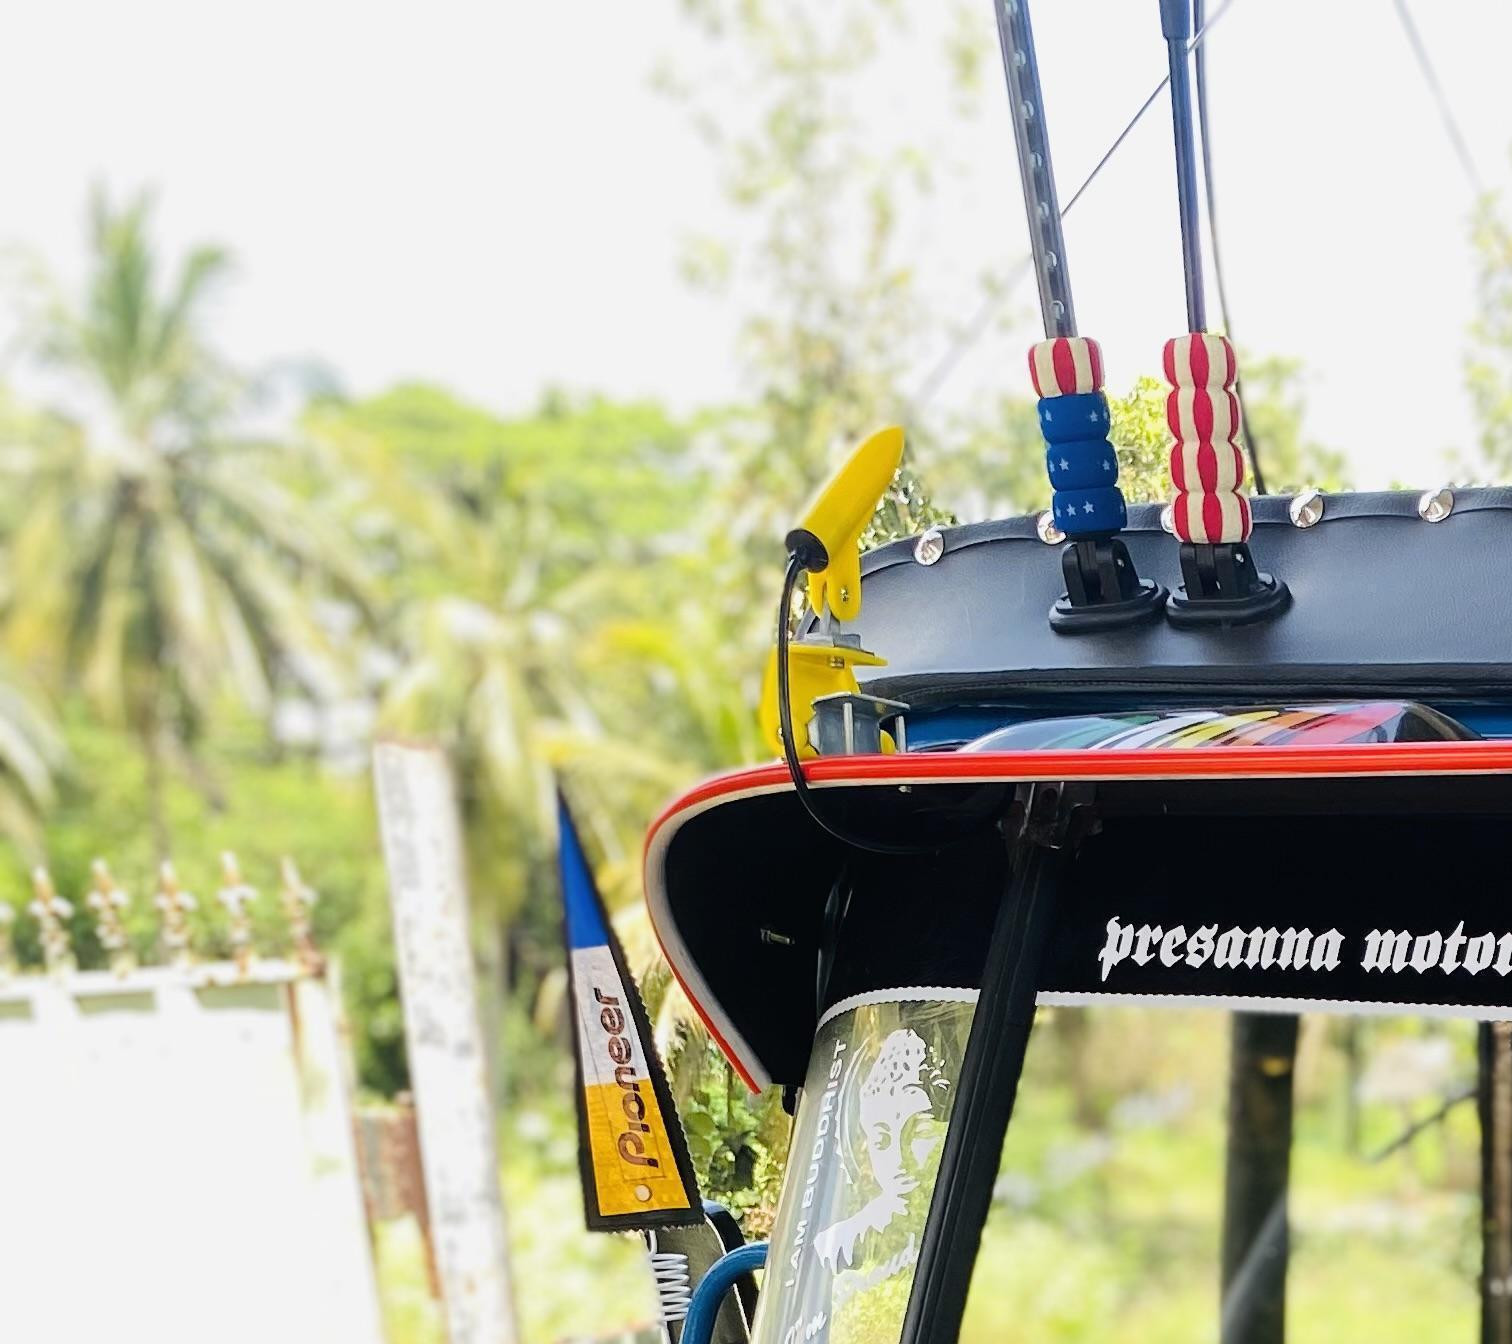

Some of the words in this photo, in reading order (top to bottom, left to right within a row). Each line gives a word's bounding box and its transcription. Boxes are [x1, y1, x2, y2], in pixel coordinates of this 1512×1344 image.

[1098, 914, 1346, 982] presanna
[593, 986, 659, 1169] Pioneer
[791, 1219, 808, 1270] AM
[801, 1039, 848, 1210] BUDDHIST
